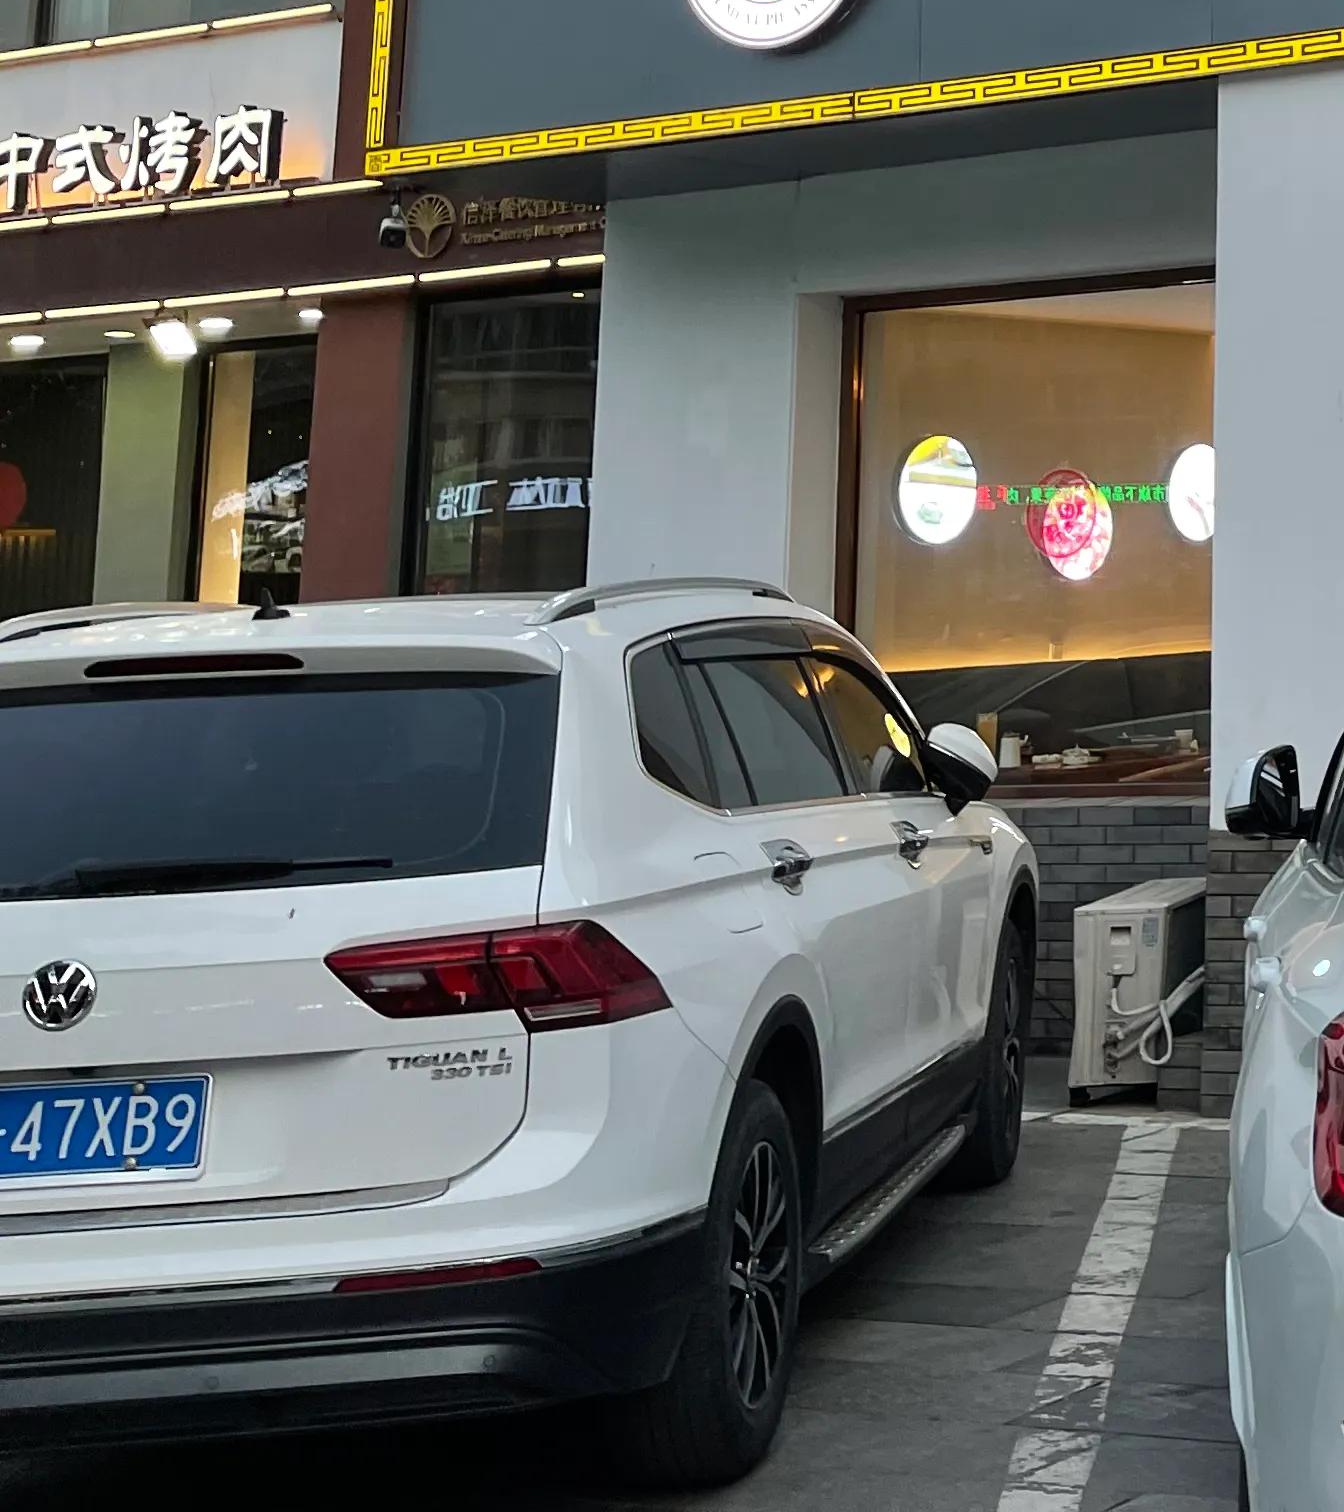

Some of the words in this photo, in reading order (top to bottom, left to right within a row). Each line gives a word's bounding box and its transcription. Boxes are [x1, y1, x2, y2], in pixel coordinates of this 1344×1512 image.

[0, 105, 272, 210] 中式烤肉
[387, 1049, 489, 1071] TIGUAN
[498, 1048, 513, 1062] L
[430, 1066, 473, 1081] 330
[477, 1063, 512, 1077] TSI
